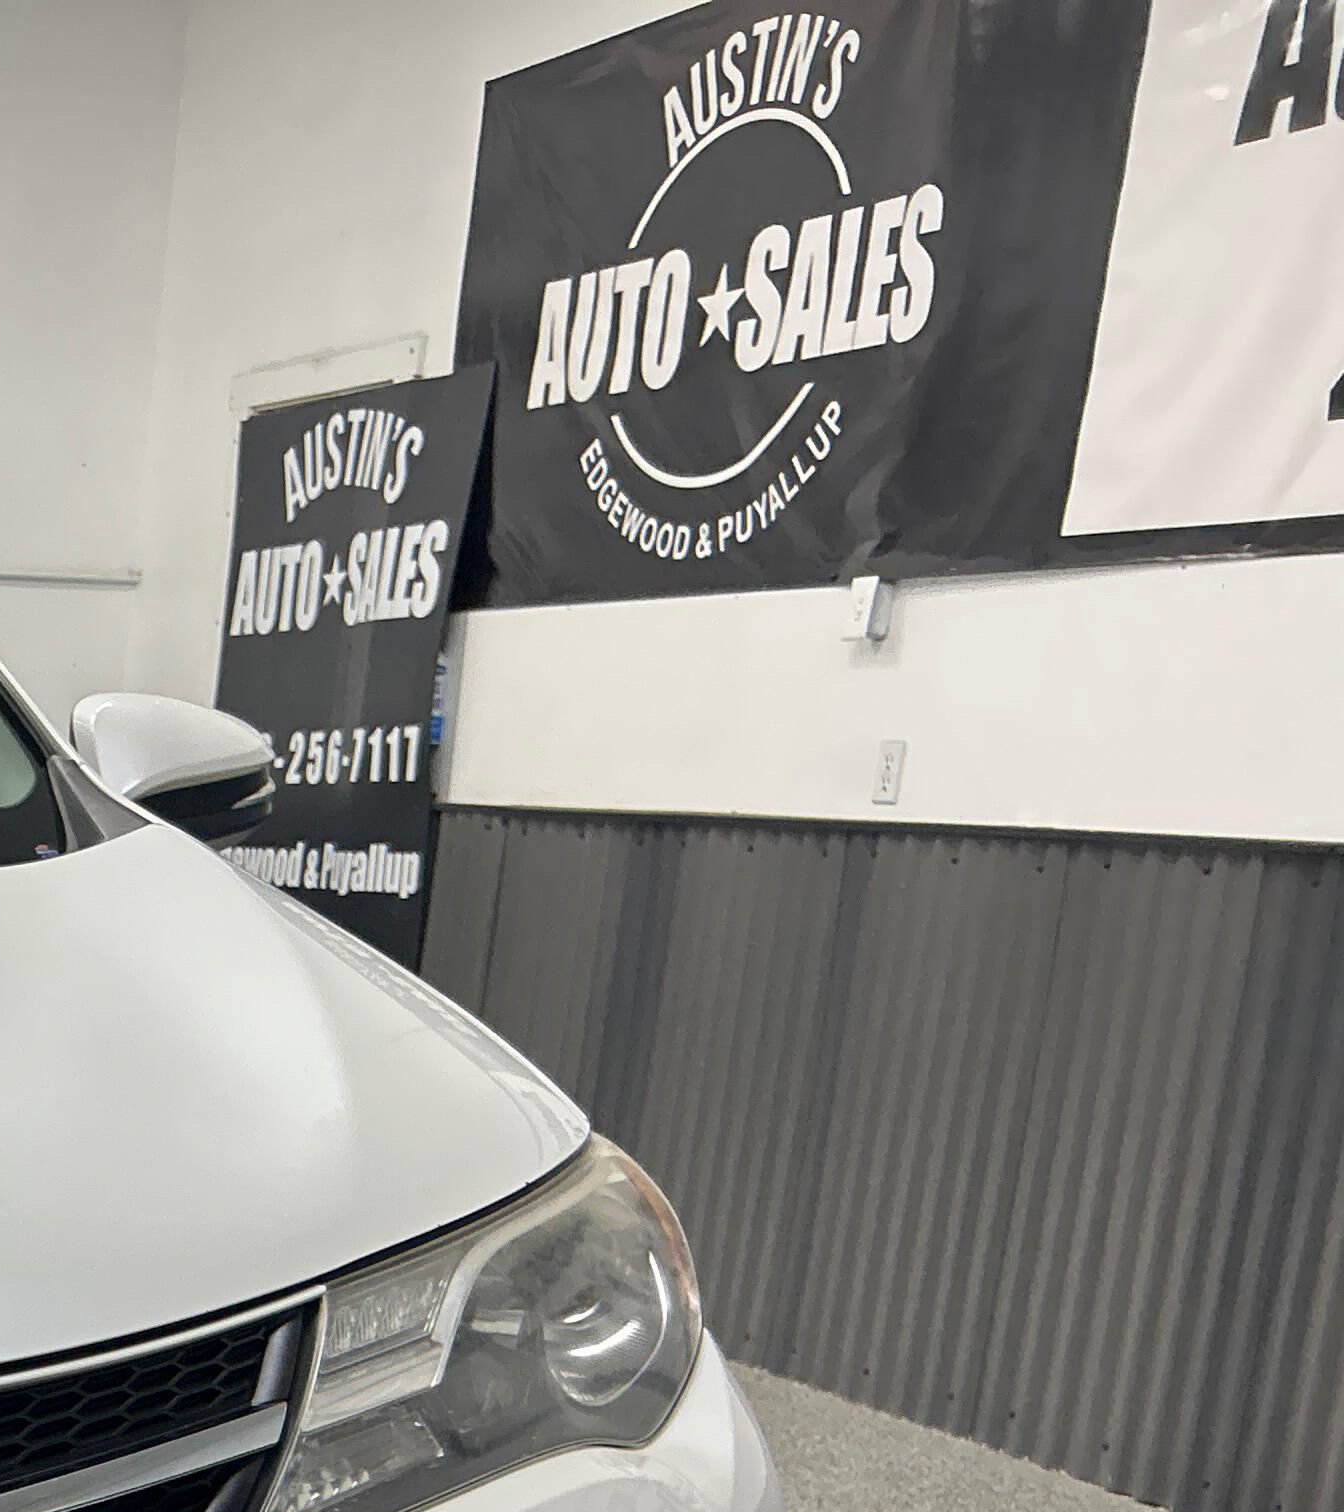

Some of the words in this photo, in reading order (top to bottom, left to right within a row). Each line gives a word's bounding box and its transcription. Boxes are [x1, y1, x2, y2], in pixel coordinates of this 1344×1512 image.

[663, 13, 861, 168] AUSTIN'S
[527, 248, 692, 410] AUTO
[734, 184, 944, 373] SALES
[282, 409, 424, 523] AUSTIN'S
[579, 438, 691, 561] EDGEWOOD
[695, 527, 713, 558] &
[717, 400, 845, 553] PUYALLUP
[230, 540, 324, 637] AUTO
[343, 520, 450, 626] SALES
[303, 849, 319, 889] &
[320, 842, 421, 900] Puyallup
